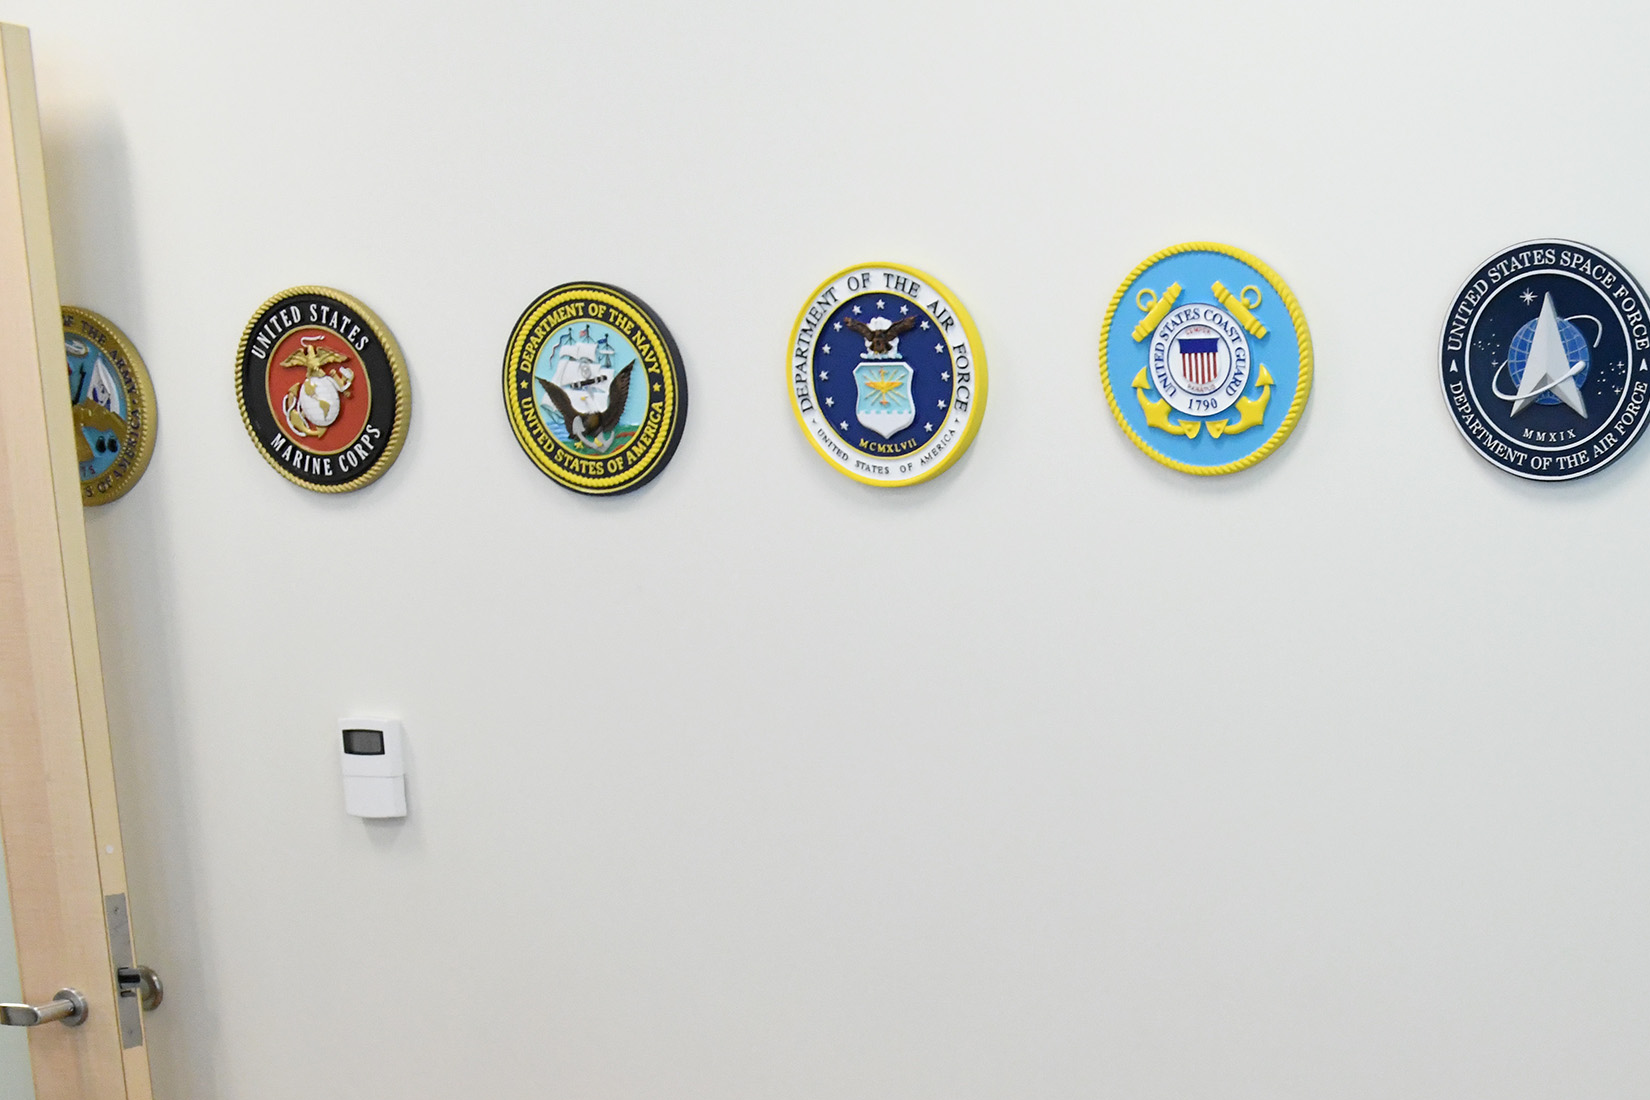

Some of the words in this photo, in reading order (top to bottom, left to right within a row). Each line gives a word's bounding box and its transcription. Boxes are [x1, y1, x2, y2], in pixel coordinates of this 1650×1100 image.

[1161, 308, 1200, 341] STATES
[1203, 309, 1242, 345] COAST
[1447, 279, 1489, 351] UNITED
[1487, 249, 1556, 278] STATES
[1560, 251, 1616, 287] SPACE
[1613, 285, 1650, 350] FORCE
[81, 320, 107, 344] THE
[109, 349, 139, 395] ARMY
[251, 305, 301, 359] UNITED
[310, 304, 369, 351] STATES
[520, 303, 584, 374] DEPARTMENT
[588, 303, 607, 318] OF
[609, 308, 632, 334] THE
[633, 332, 661, 374] NAVY
[795, 287, 838, 413] DEPARTMENT
[847, 272, 871, 291] OF
[883, 272, 921, 298] THE
[927, 299, 955, 332] AIR
[952, 343, 971, 413] FORCE
[1154, 342, 1177, 398] UNITED
[1225, 346, 1247, 396] GUARD
[1188, 397, 1218, 411] 1790
[1450, 381, 1527, 467] DEPARTMENT
[1530, 456, 1552, 470] OF
[1556, 450, 1590, 470] THE
[1593, 433, 1617, 458] AIR
[1614, 381, 1648, 436] FORCE
[113, 408, 140, 479] AMERICA
[270, 433, 333, 476] MARINE
[338, 424, 381, 472] CORPS
[521, 397, 555, 452] UNITED
[554, 449, 604, 475] STATES
[607, 460, 624, 474] OF
[628, 401, 663, 465] AMERICA
[817, 428, 849, 461] UNITED
[855, 460, 890, 474] STATES
[900, 463, 913, 473] OF
[920, 429, 955, 466] AMERICA
[859, 438, 917, 453] MCMXLVII
[1523, 428, 1576, 442] MMXIX
